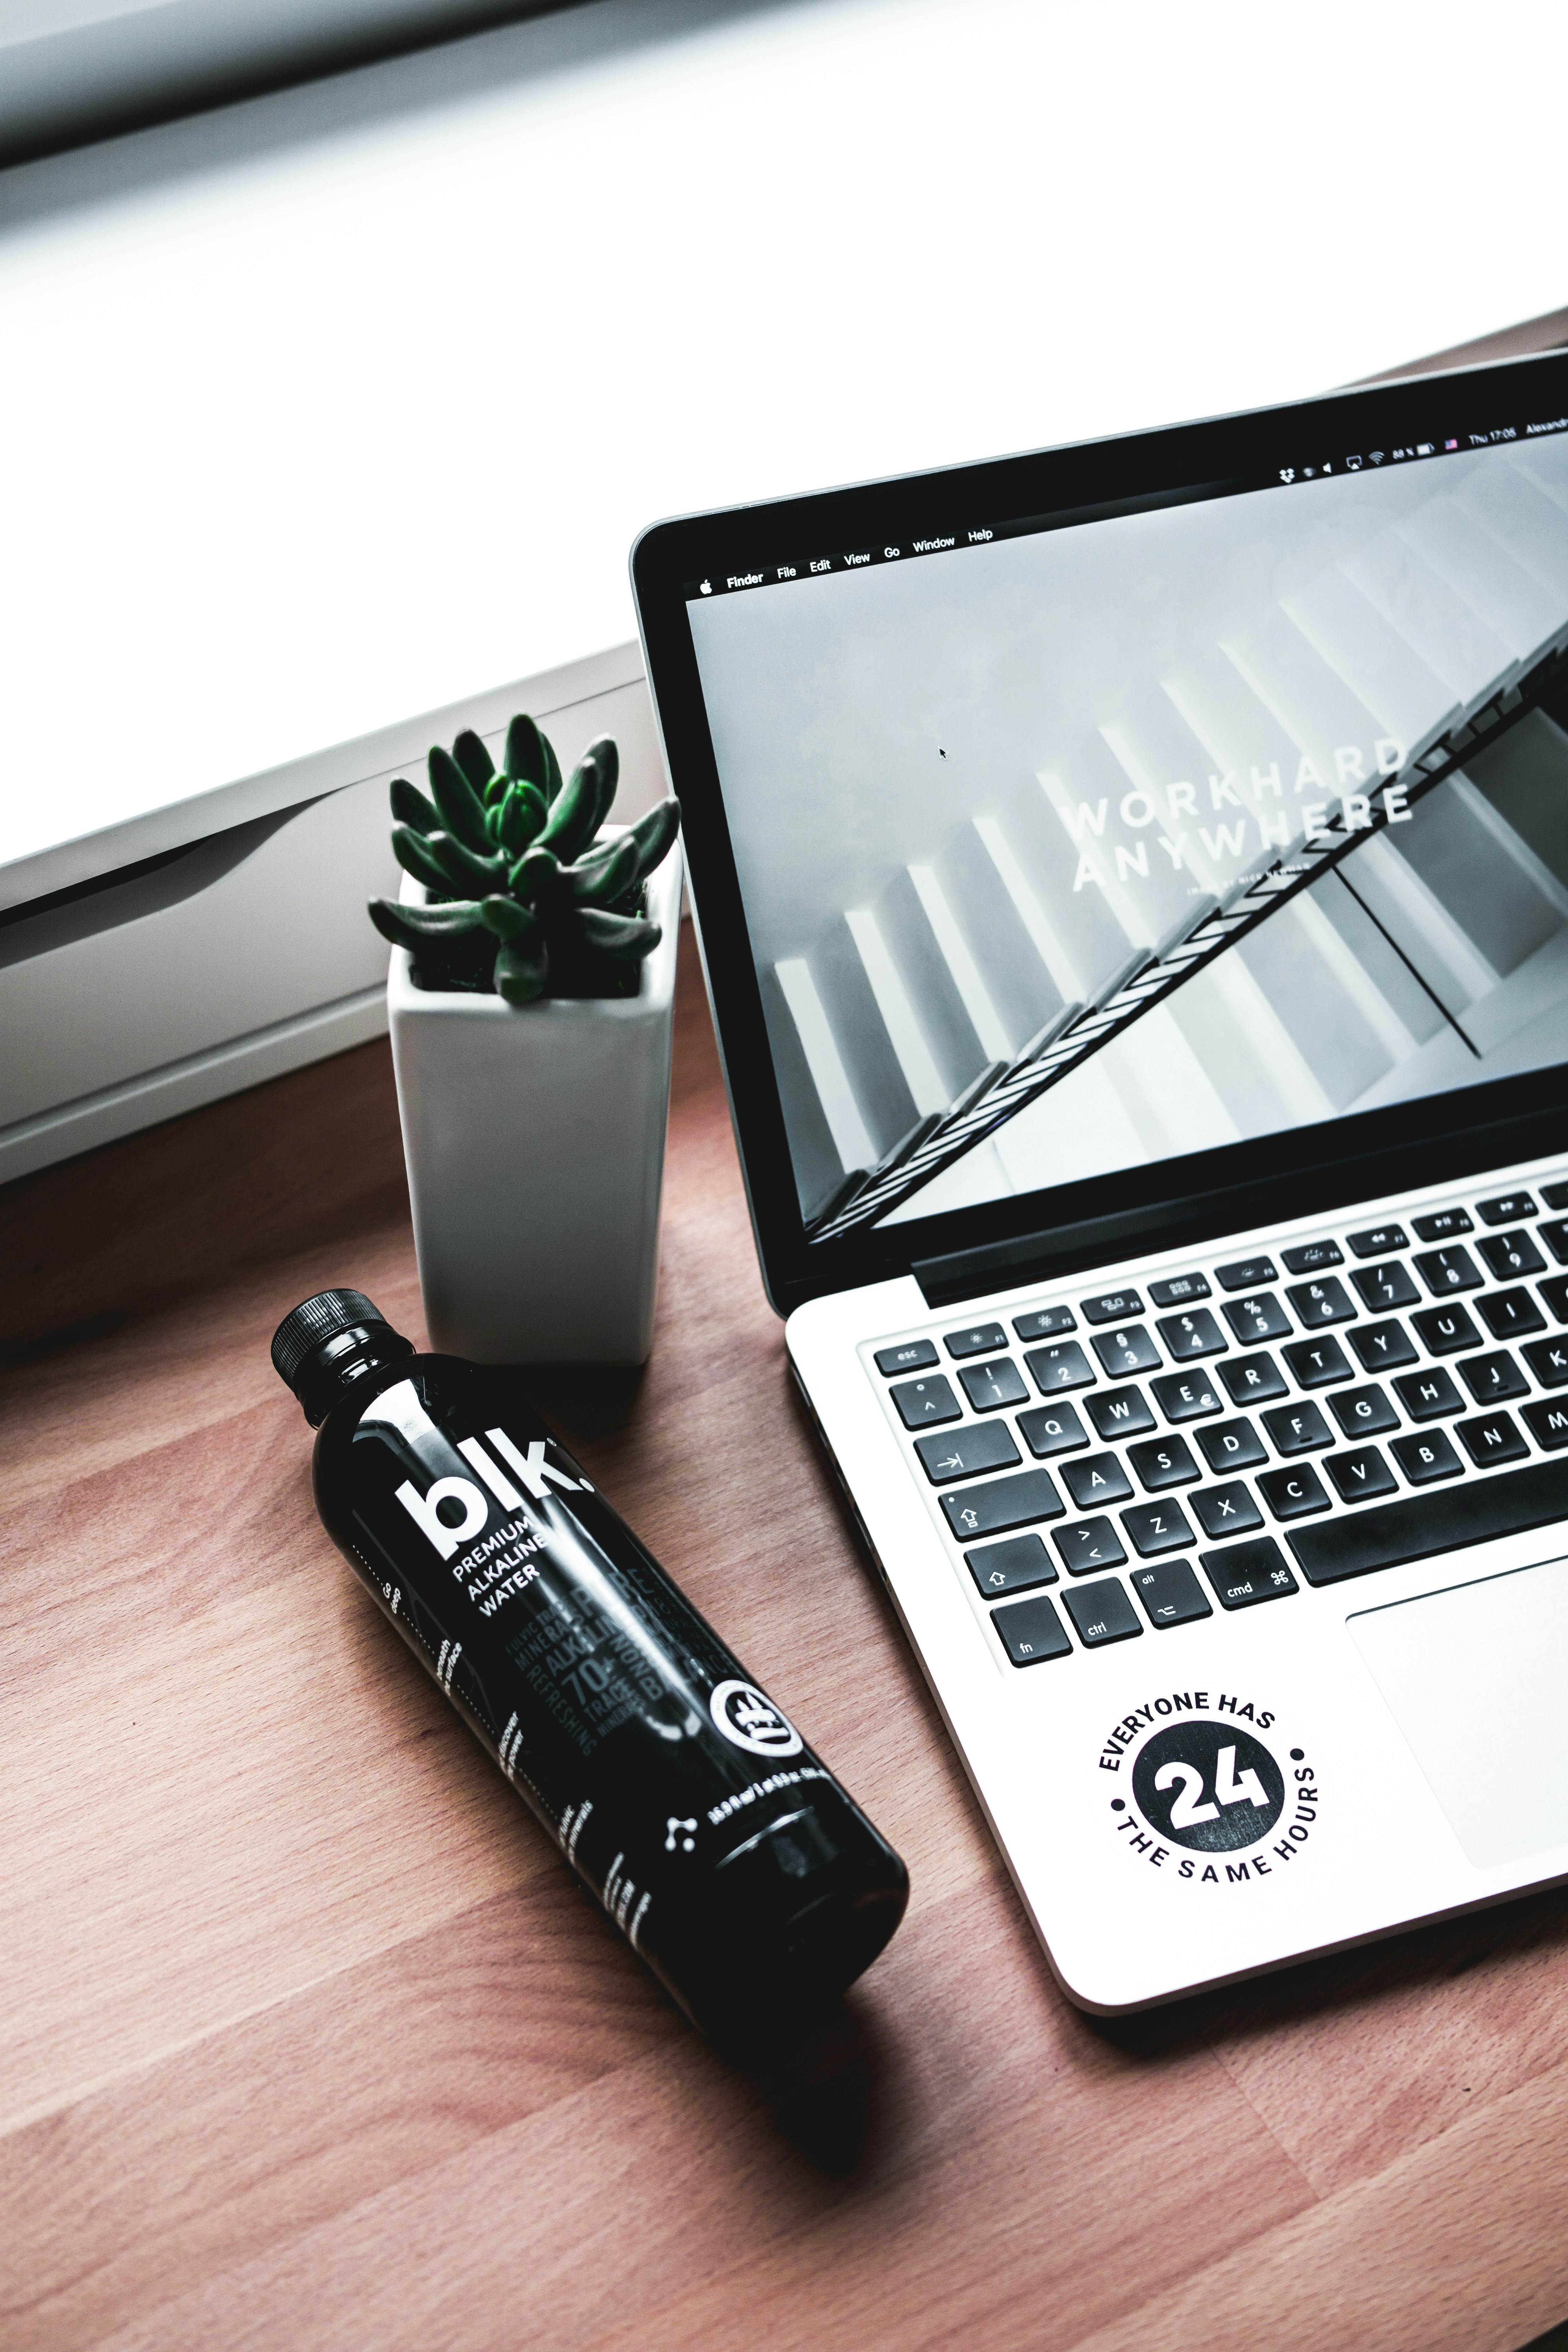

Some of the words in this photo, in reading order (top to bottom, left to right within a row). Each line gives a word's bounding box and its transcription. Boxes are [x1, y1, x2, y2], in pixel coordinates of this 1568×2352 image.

[1468, 434, 1488, 445] Thu
[727, 572, 764, 588] Finder
[777, 566, 796, 578] File
[810, 560, 831, 572] Edit
[844, 552, 870, 566] View
[884, 547, 900, 558] Go
[913, 535, 955, 552] Window
[968, 529, 993, 542] Help
[1060, 738, 1408, 840] WORKHARD
[1073, 783, 1413, 892] ANYWHERE
[1509, 1253, 1521, 1267] 9
[1446, 1269, 1460, 1283] 8
[1197, 1284, 1207, 1292] F4
[1310, 1285, 1324, 1299] &
[1383, 1285, 1394, 1299] 7
[1244, 1301, 1261, 1315] %
[1321, 1301, 1334, 1316] 6
[1062, 1317, 1072, 1325] F2
[1181, 1317, 1194, 1332] $
[1256, 1317, 1269, 1333] 5
[1438, 1318, 1455, 1335] U
[995, 1335, 1004, 1343] F1
[1191, 1334, 1203, 1348] 4
[1374, 1335, 1387, 1351] Y
[897, 1350, 917, 1361] esc
[1125, 1351, 1140, 1366] 3
[1310, 1352, 1323, 1367] T
[1550, 1350, 1567, 1367] K
[985, 1367, 994, 1382] !
[1058, 1367, 1074, 1383] 2
[1245, 1369, 1261, 1385] R
[1491, 1367, 1499, 1383] J
[992, 1385, 1003, 1399] 1
[1180, 1386, 1194, 1402] E
[1420, 1383, 1438, 1400] H
[1198, 1394, 1216, 1408] €
[1355, 1401, 1372, 1417] G
[1109, 1401, 1130, 1419] W
[1045, 1420, 1063, 1436] Q
[1291, 1418, 1302, 1434] F
[1548, 1412, 1568, 1429] M
[1223, 1436, 1239, 1452] D
[1484, 1428, 1502, 1445] N
[1157, 1453, 1171, 1469] S
[1419, 1447, 1434, 1463] B
[1092, 1471, 1106, 1487] A
[1351, 1463, 1365, 1479] V
[394, 1427, 595, 1561] blk.
[1287, 1482, 1303, 1497] C
[1218, 1499, 1236, 1516] X
[1150, 1517, 1167, 1534] Z
[452, 1515, 535, 1583] PREMIUM
[467, 1532, 549, 1602] ALKALINE
[1142, 1575, 1154, 1584] alt
[382, 1582, 391, 1599] Go
[478, 1564, 540, 1617] WATER
[1227, 1581, 1253, 1597] cmd
[391, 1587, 401, 1614] deep
[1088, 1621, 1107, 1635] ctrl
[514, 1612, 585, 1672] MINERAS
[1020, 1643, 1033, 1653] fn
[436, 1639, 451, 1681] beneath
[445, 1642, 462, 1682] surface
[1099, 1691, 1209, 1771] EVERYONE
[1218, 1694, 1276, 1729] HAS
[1154, 1745, 1270, 1830] 24
[1117, 1815, 1170, 1867] THE
[1178, 1855, 1272, 1883] SAME
[1273, 1767, 1318, 1861] HOURS
